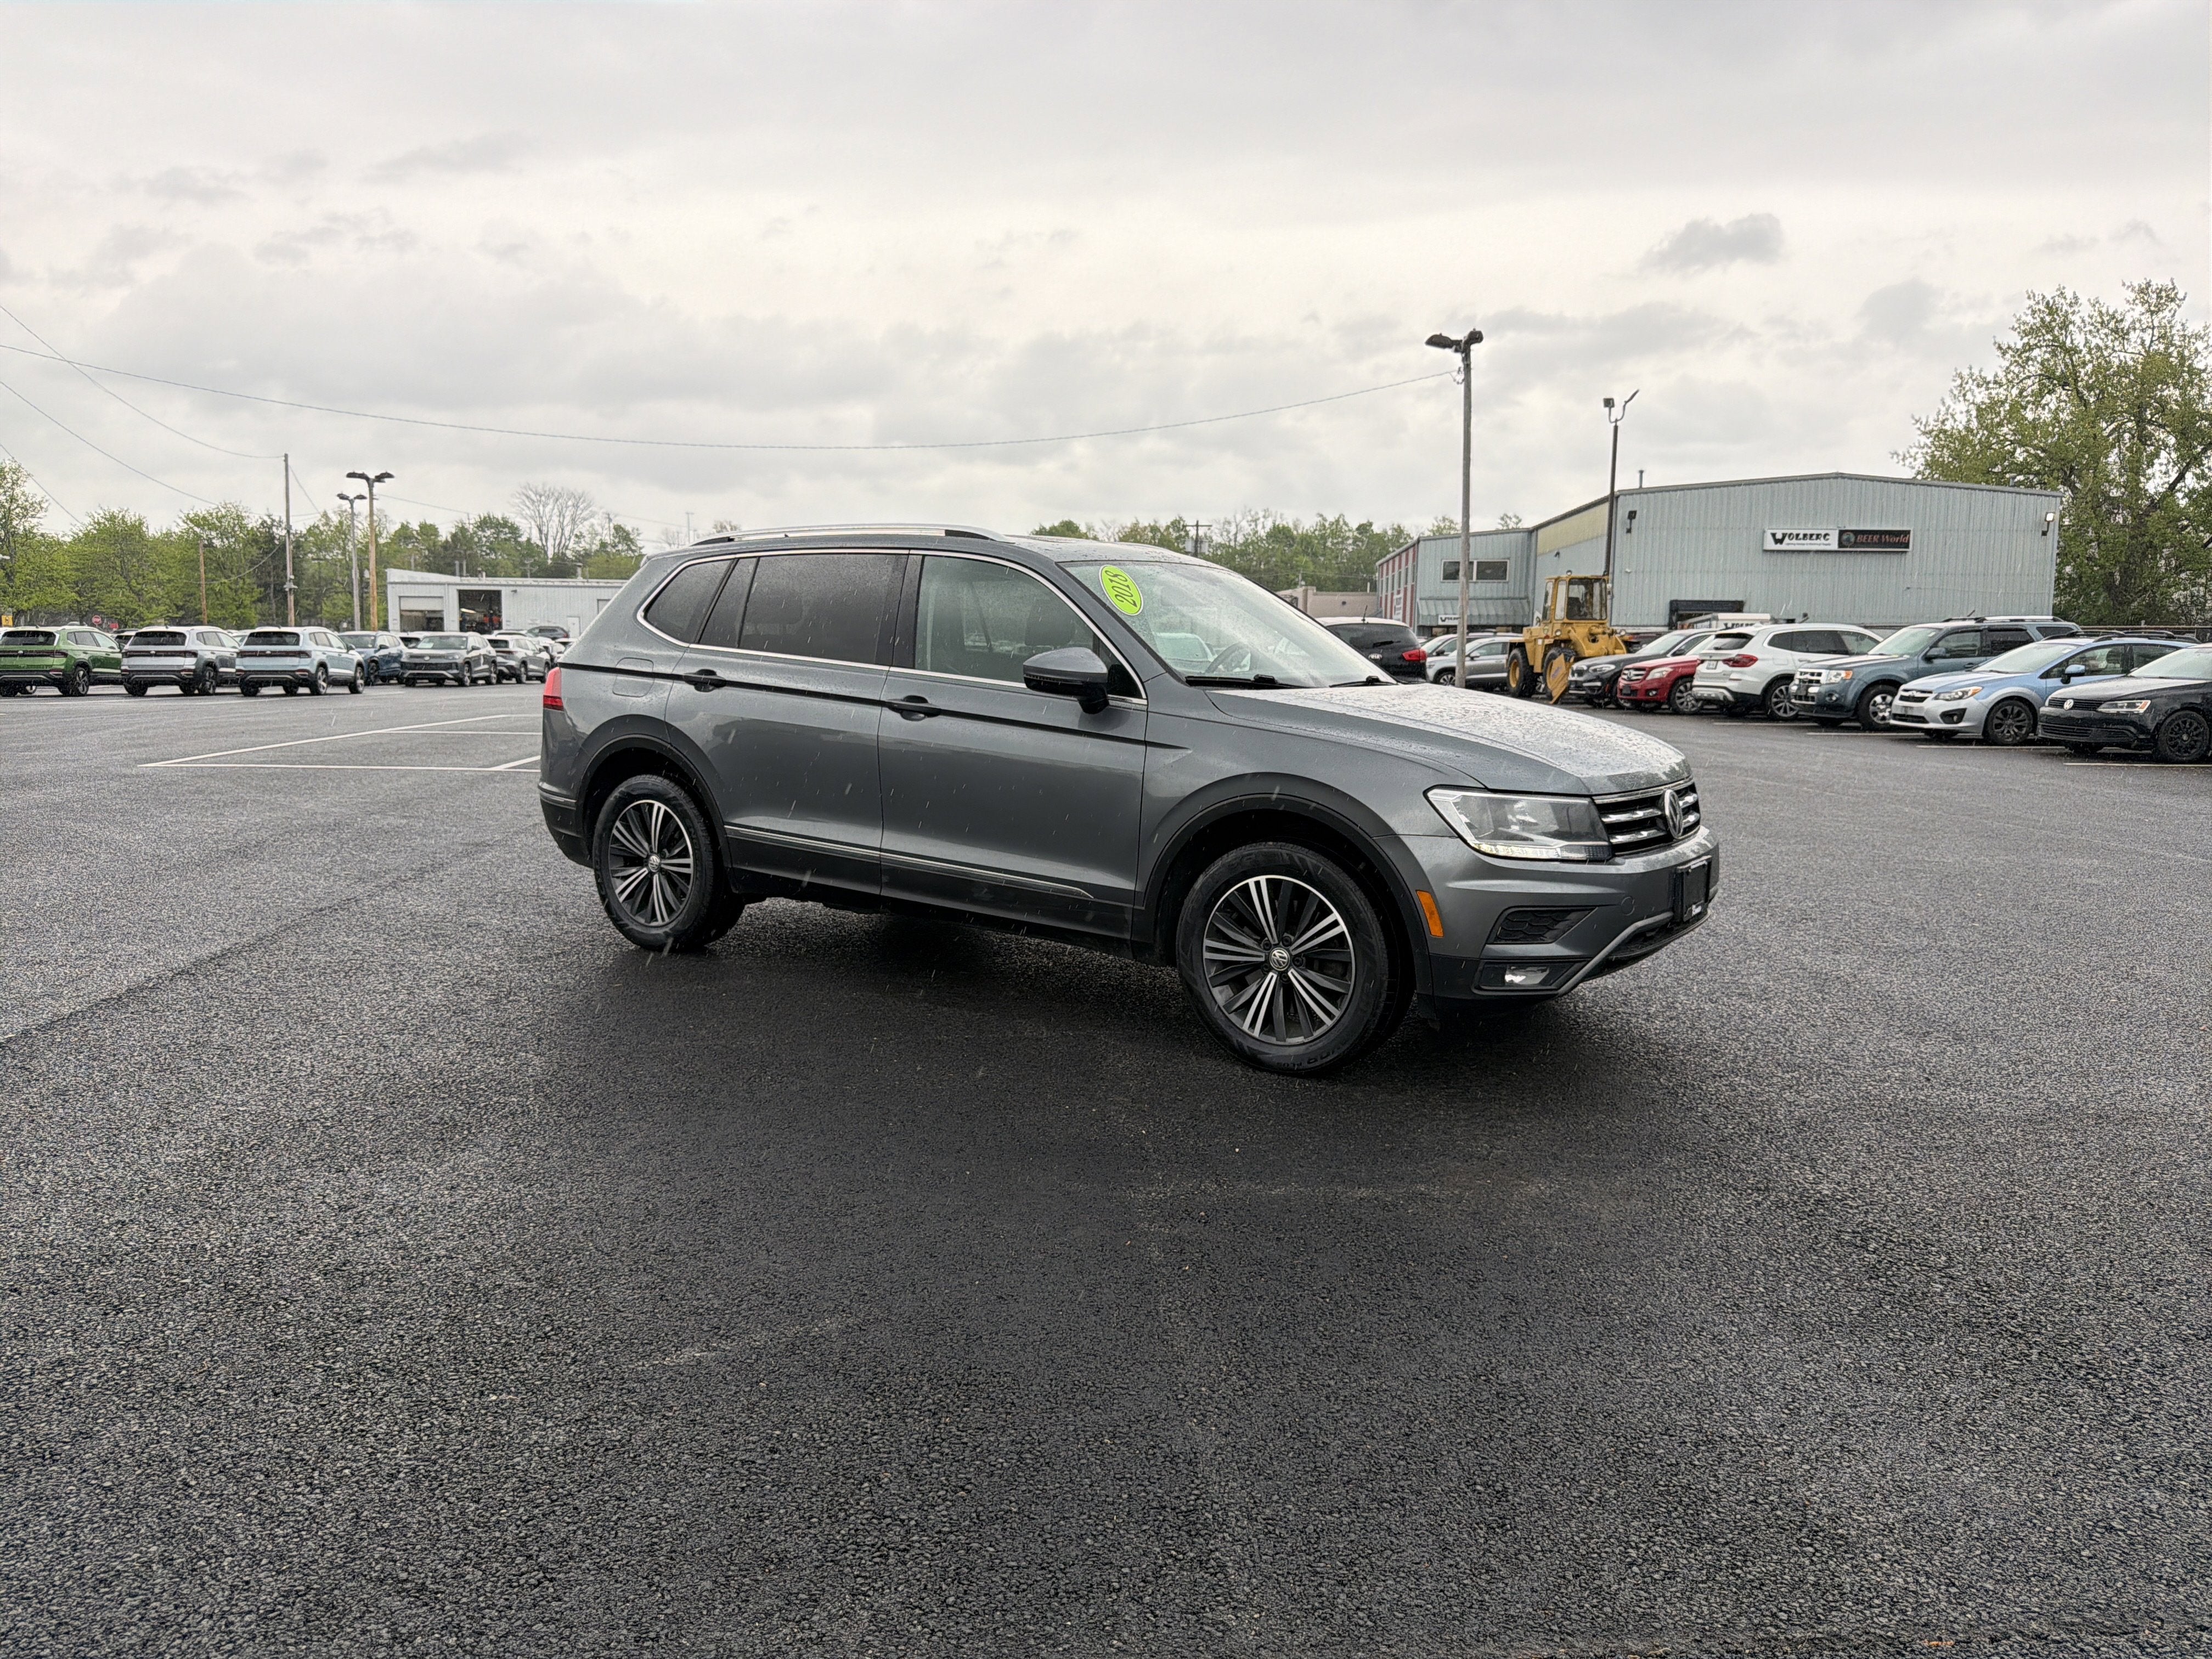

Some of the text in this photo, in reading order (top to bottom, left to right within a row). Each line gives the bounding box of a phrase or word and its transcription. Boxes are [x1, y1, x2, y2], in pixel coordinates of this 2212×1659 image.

[1857, 533, 1910, 543] BEER World
[1104, 570, 1138, 608] 2018
